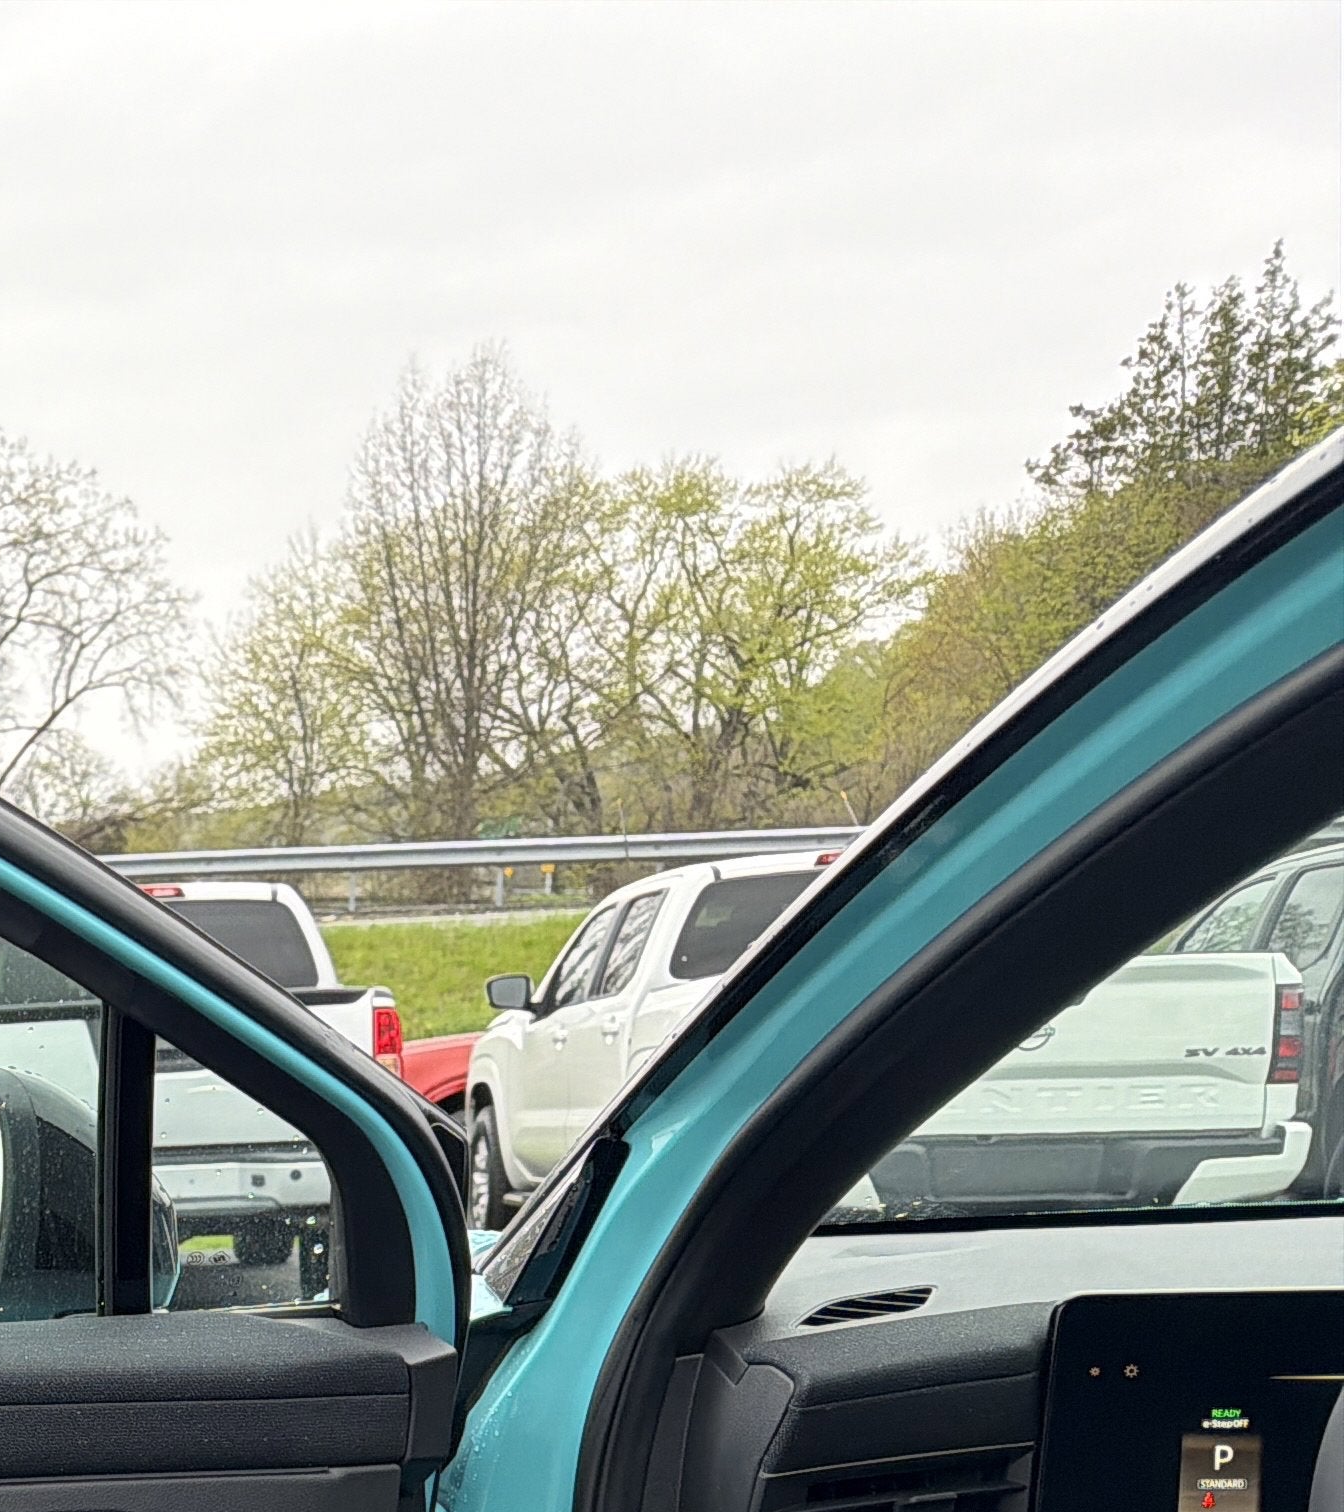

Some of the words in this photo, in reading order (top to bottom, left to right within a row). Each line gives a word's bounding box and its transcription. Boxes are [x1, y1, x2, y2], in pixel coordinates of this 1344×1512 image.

[1211, 1408, 1242, 1418] READY
[1214, 1444, 1234, 1471] P
[1200, 1479, 1245, 1489] STANDARD
